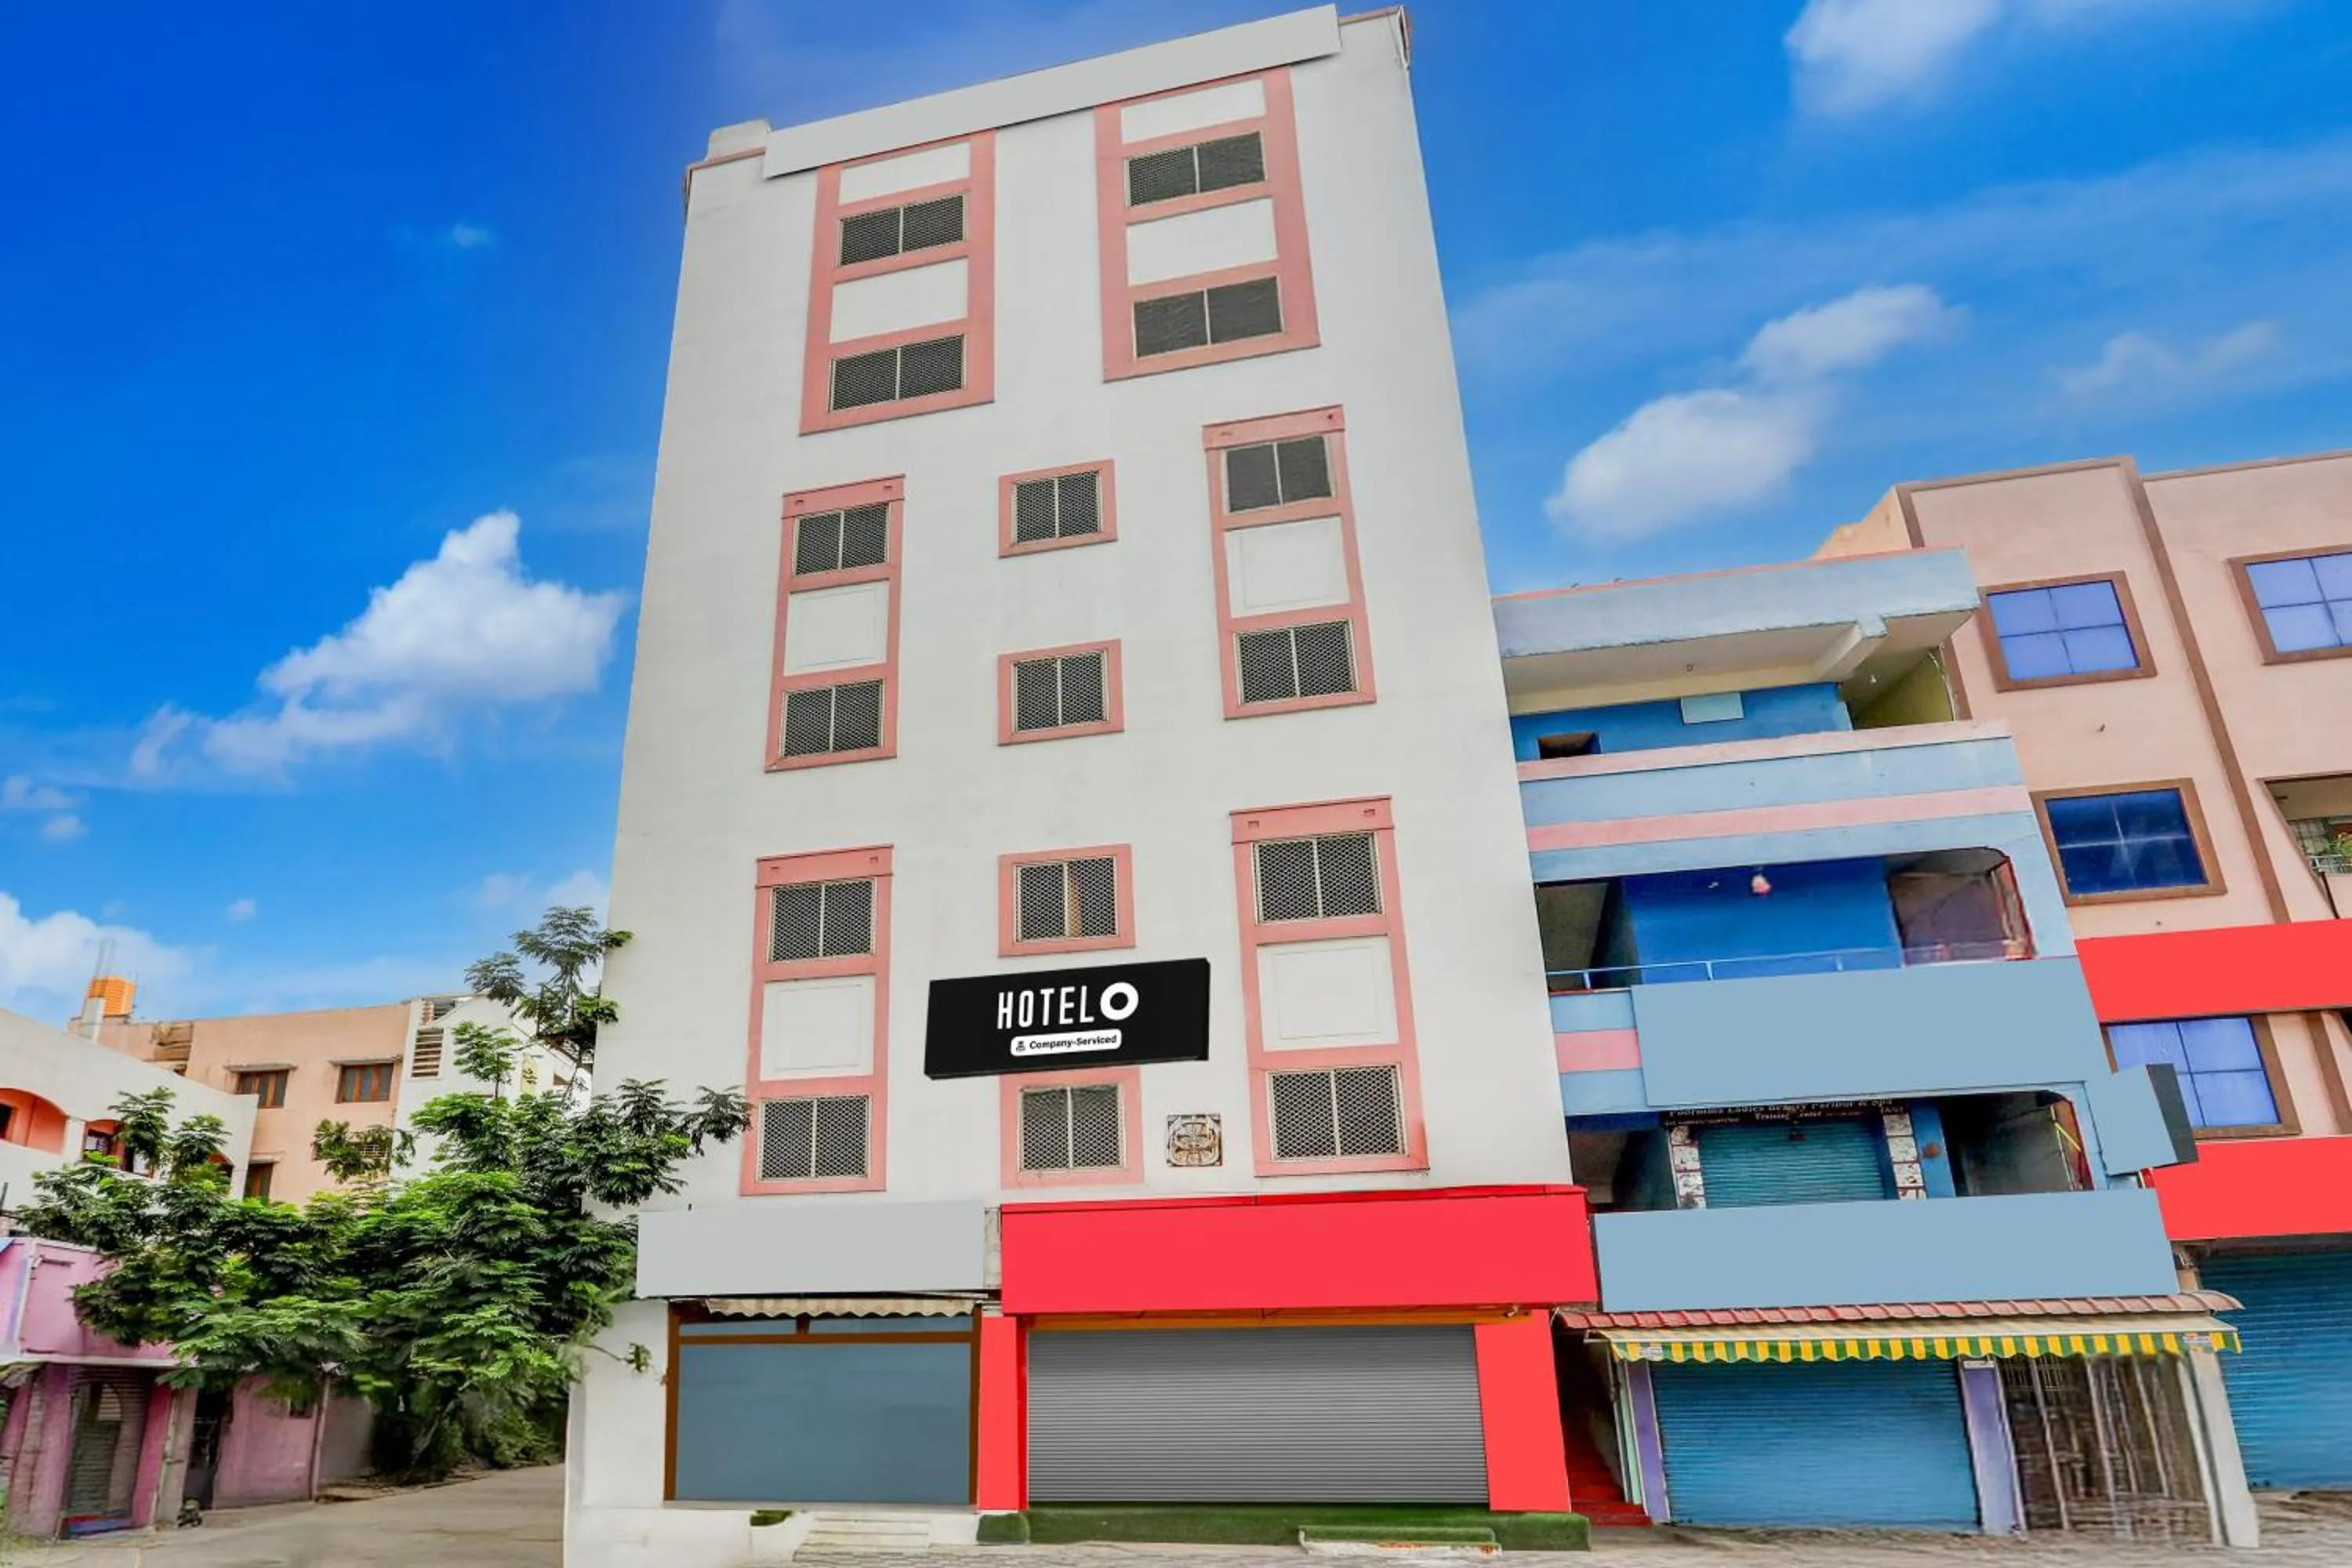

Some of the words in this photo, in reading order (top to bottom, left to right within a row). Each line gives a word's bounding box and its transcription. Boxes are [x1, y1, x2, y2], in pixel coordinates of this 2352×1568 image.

[996, 985, 1094, 1029] HOTEL
[1100, 982, 1139, 1021] O
[1029, 1034, 1117, 1049] Company-Serviced
